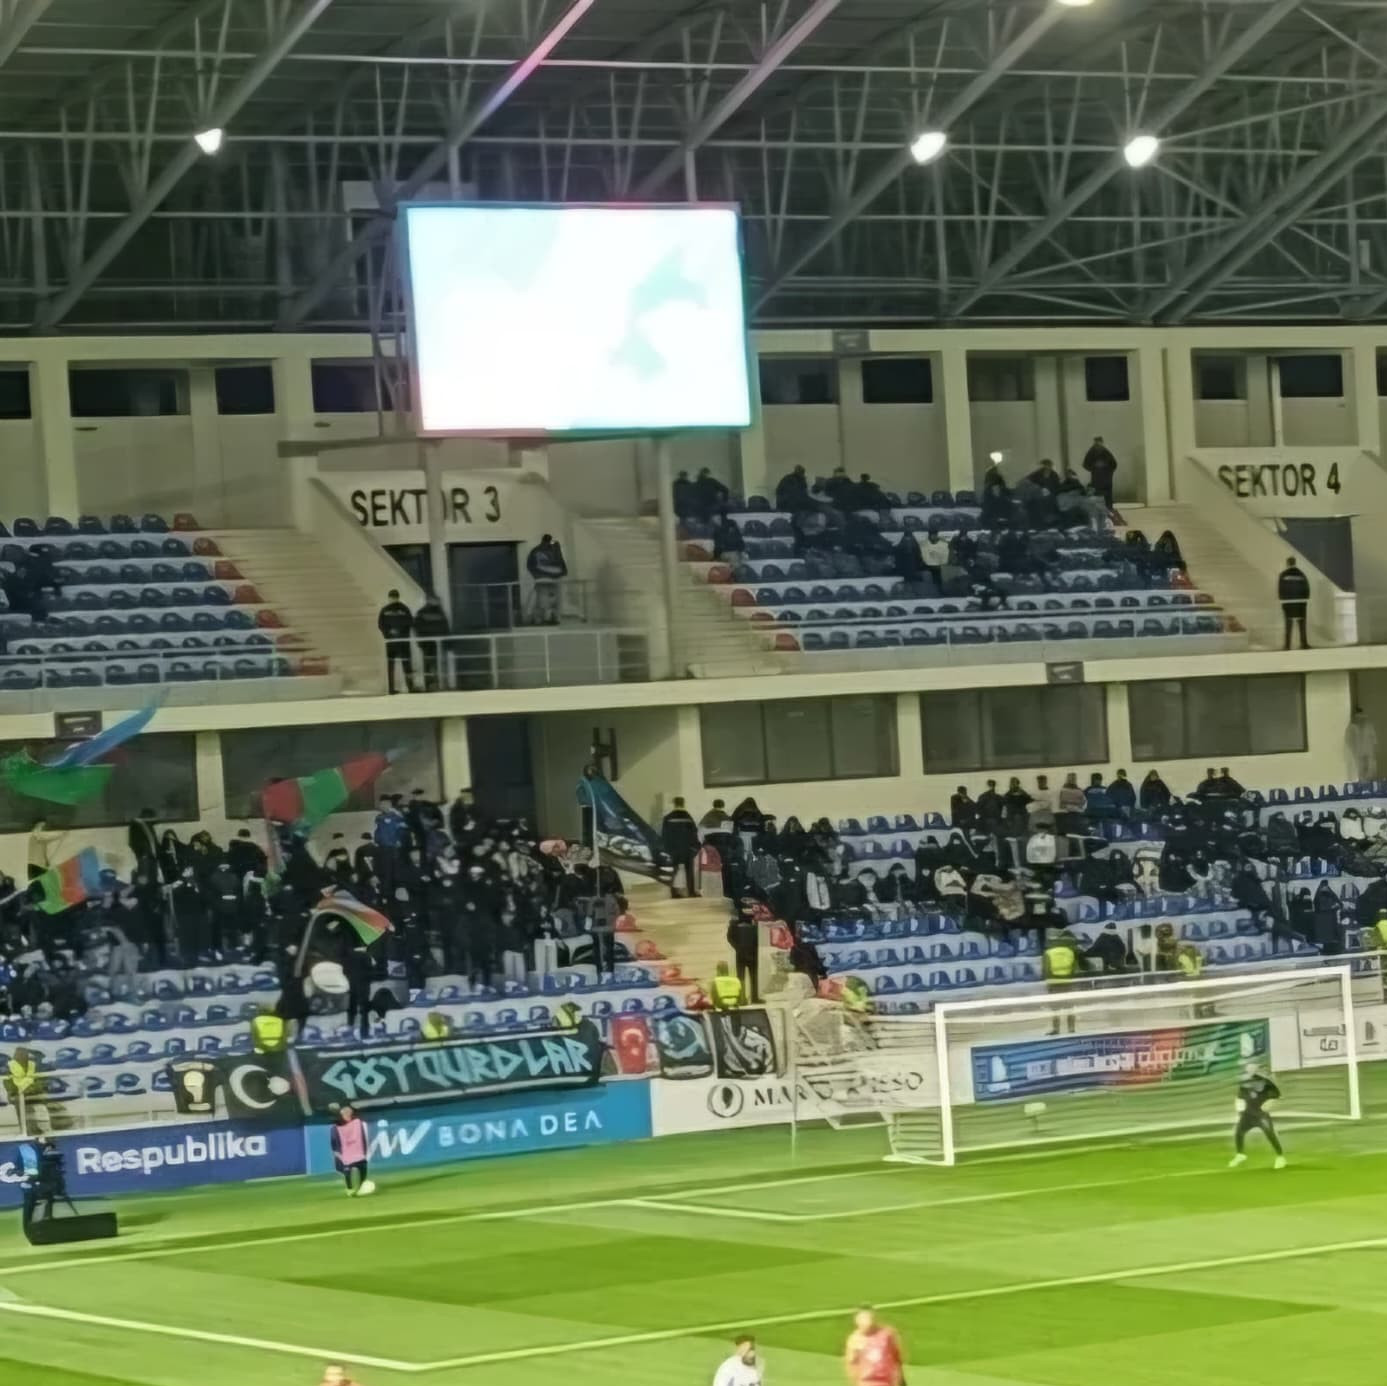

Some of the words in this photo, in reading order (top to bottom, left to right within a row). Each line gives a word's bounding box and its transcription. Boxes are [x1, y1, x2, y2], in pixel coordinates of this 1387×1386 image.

[1217, 463, 1317, 497] SEKTOR
[1326, 462, 1341, 495] 4
[351, 487, 472, 526] SEKTR
[483, 486, 500, 522] 3
[76, 1130, 268, 1175] Respublika
[366, 1118, 432, 1163] iv
[438, 1119, 529, 1148] BONA
[540, 1110, 602, 1137] DEA
